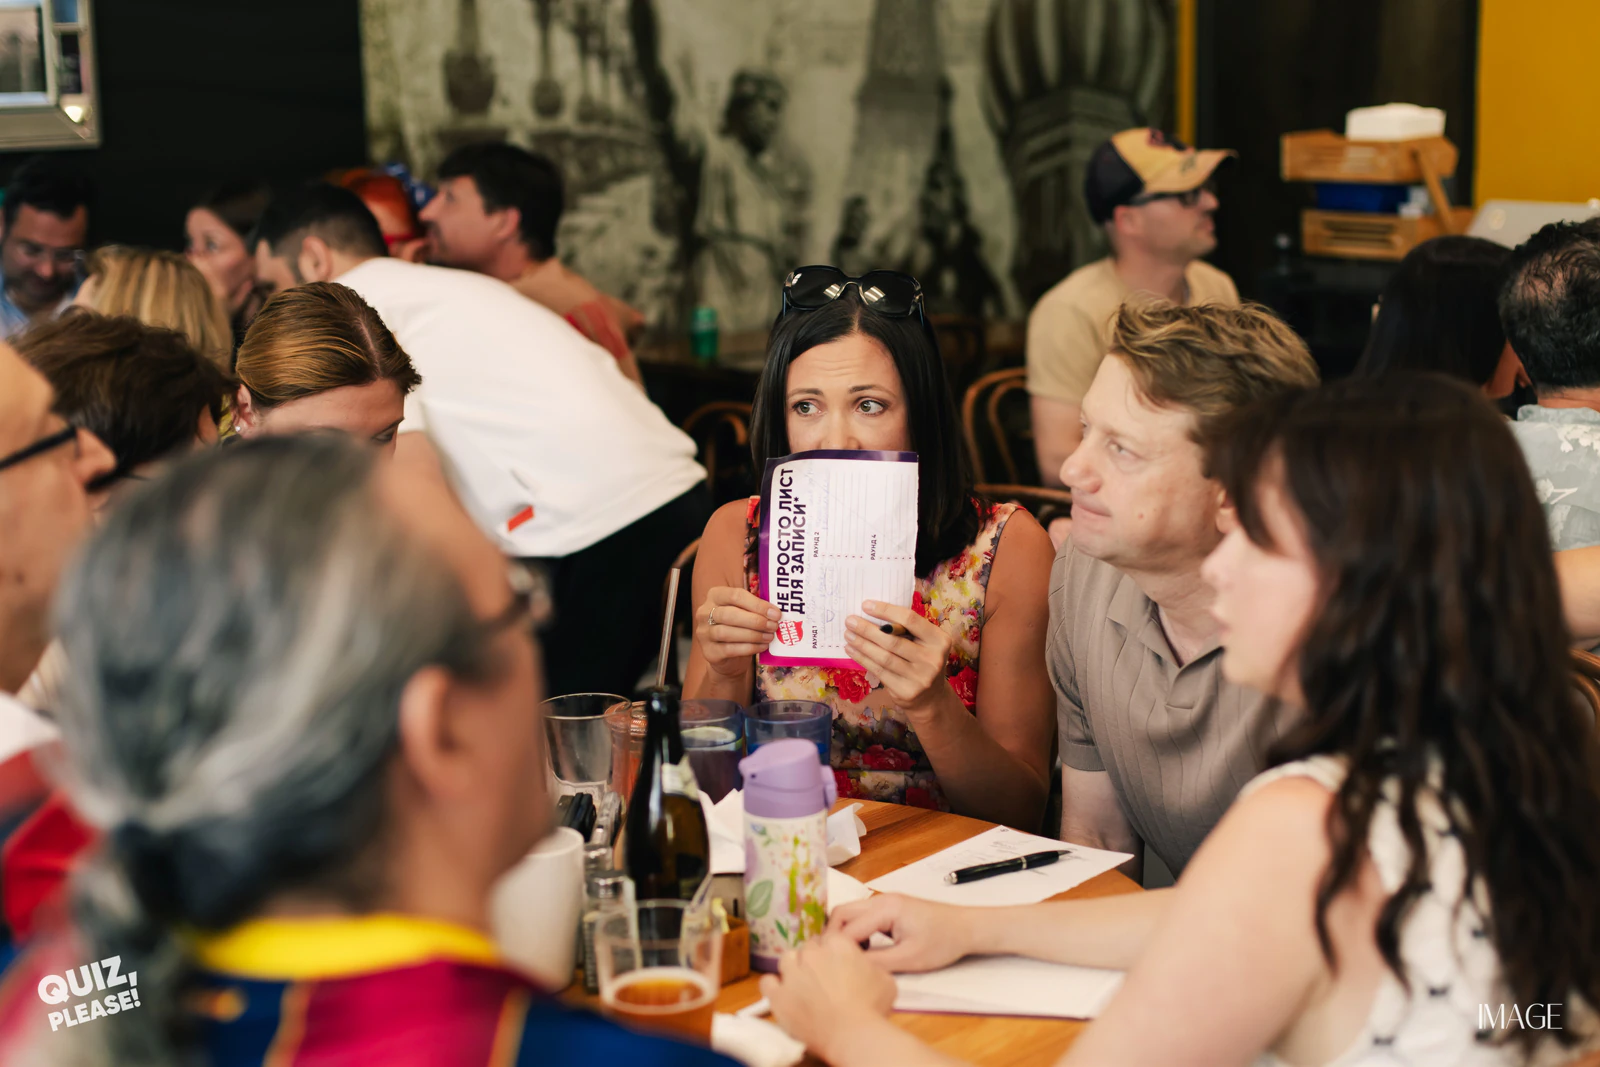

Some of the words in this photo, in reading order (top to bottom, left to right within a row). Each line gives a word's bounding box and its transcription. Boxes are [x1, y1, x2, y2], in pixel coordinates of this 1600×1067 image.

[779, 468, 794, 511] ЛИСТ
[777, 516, 791, 588] ПРОСТО
[777, 591, 789, 613] НЕ
[790, 579, 806, 615] ДЛЯ
